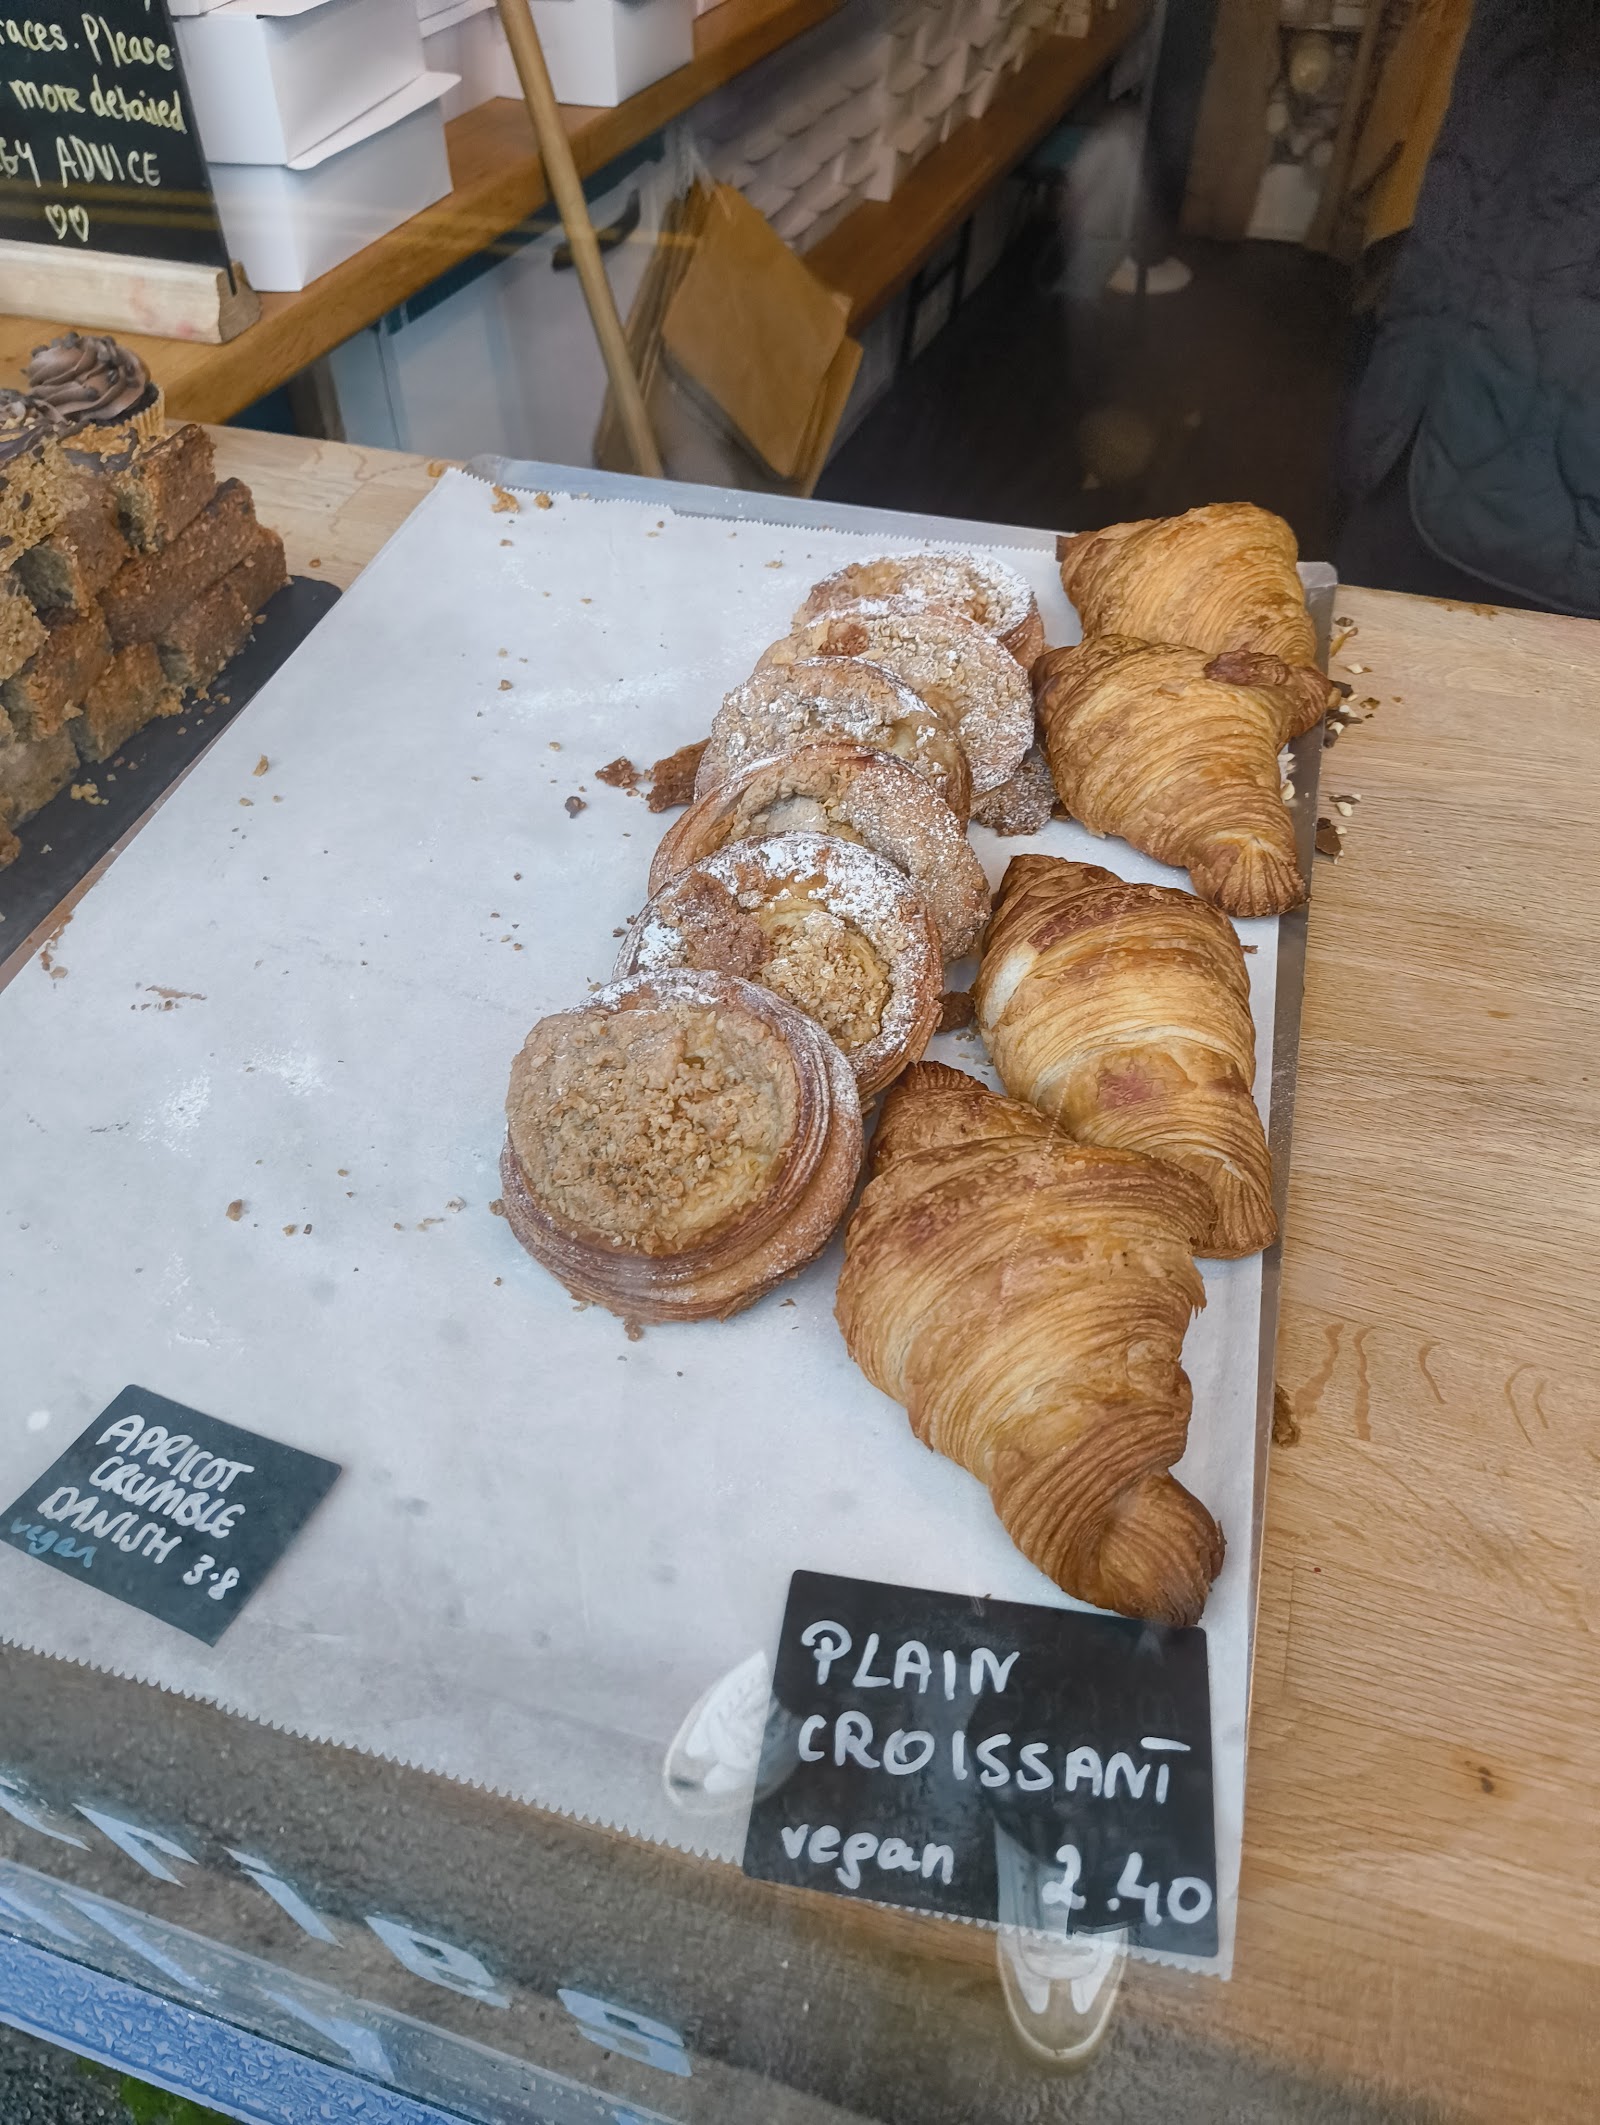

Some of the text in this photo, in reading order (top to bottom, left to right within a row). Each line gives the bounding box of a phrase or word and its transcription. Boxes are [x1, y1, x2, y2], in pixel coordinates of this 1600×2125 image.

[81, 13, 174, 71] Please
[9, 74, 187, 134] more detailed
[56, 134, 160, 188] ADVICE
[95, 1414, 255, 1492] APRICOT
[37, 1486, 182, 1564] DANISH
[89, 1456, 246, 1538] CRUMBLE
[10, 1517, 97, 1568] vegan
[801, 1620, 1020, 1700] PLAIN
[799, 1711, 1191, 1803] CROISSANT
[780, 1824, 1212, 1926] vegan 2.40
